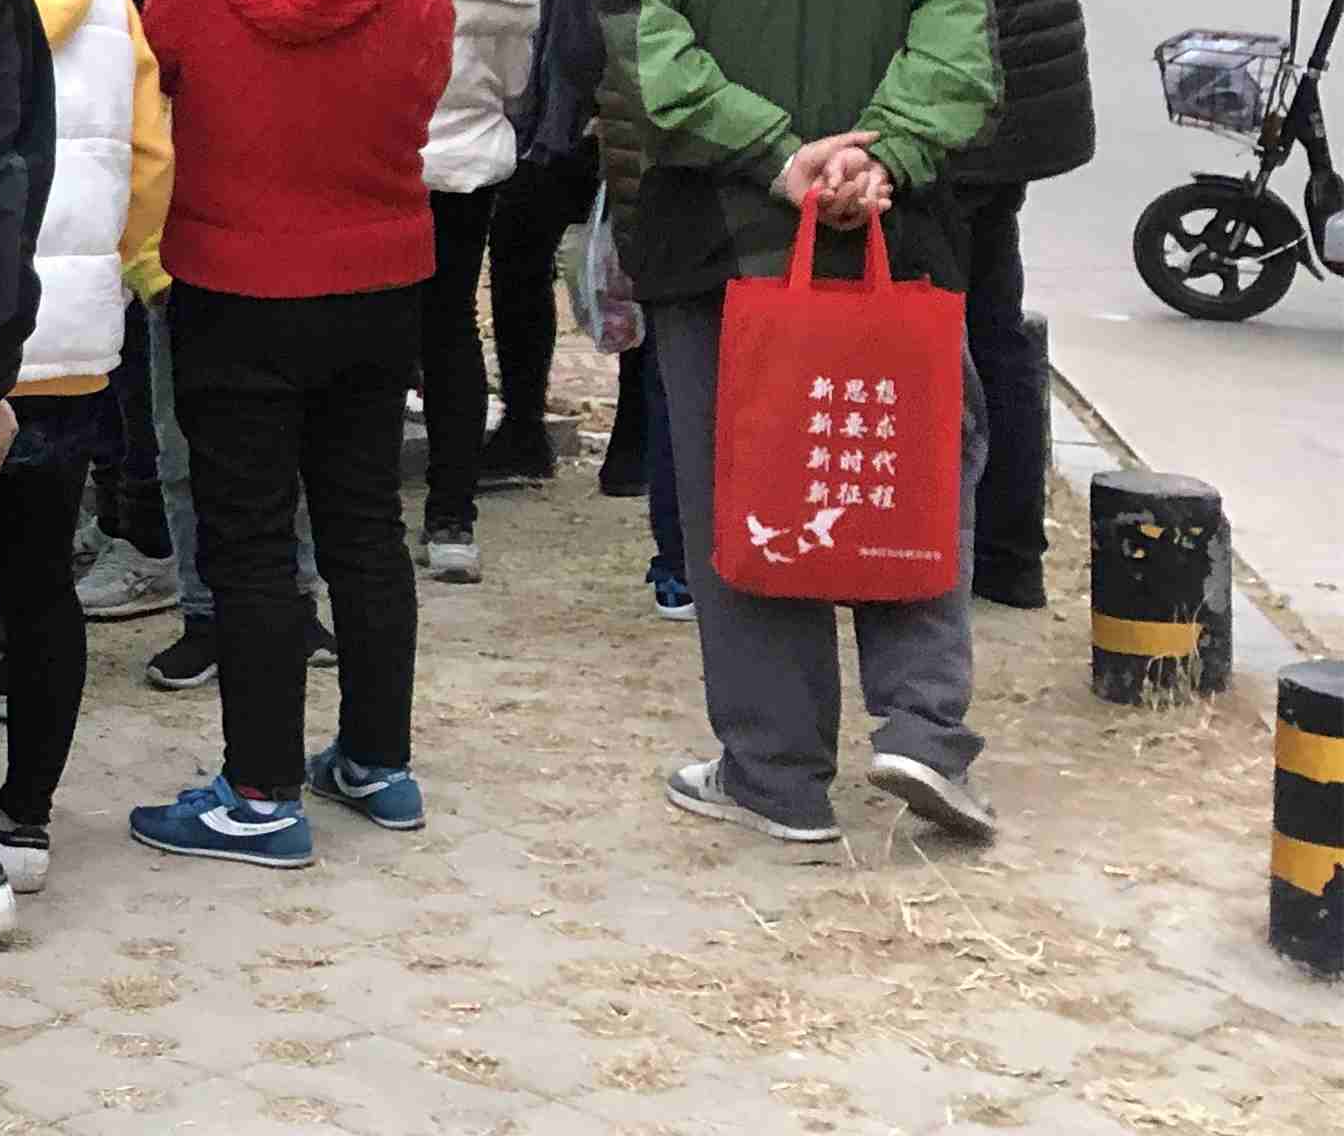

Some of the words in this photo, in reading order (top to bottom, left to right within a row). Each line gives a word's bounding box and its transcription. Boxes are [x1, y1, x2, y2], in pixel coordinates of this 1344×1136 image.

[808, 376, 897, 405] 新思想
[808, 411, 896, 441] 新要求
[806, 445, 897, 475] 新时代
[805, 480, 897, 510] 新征程
